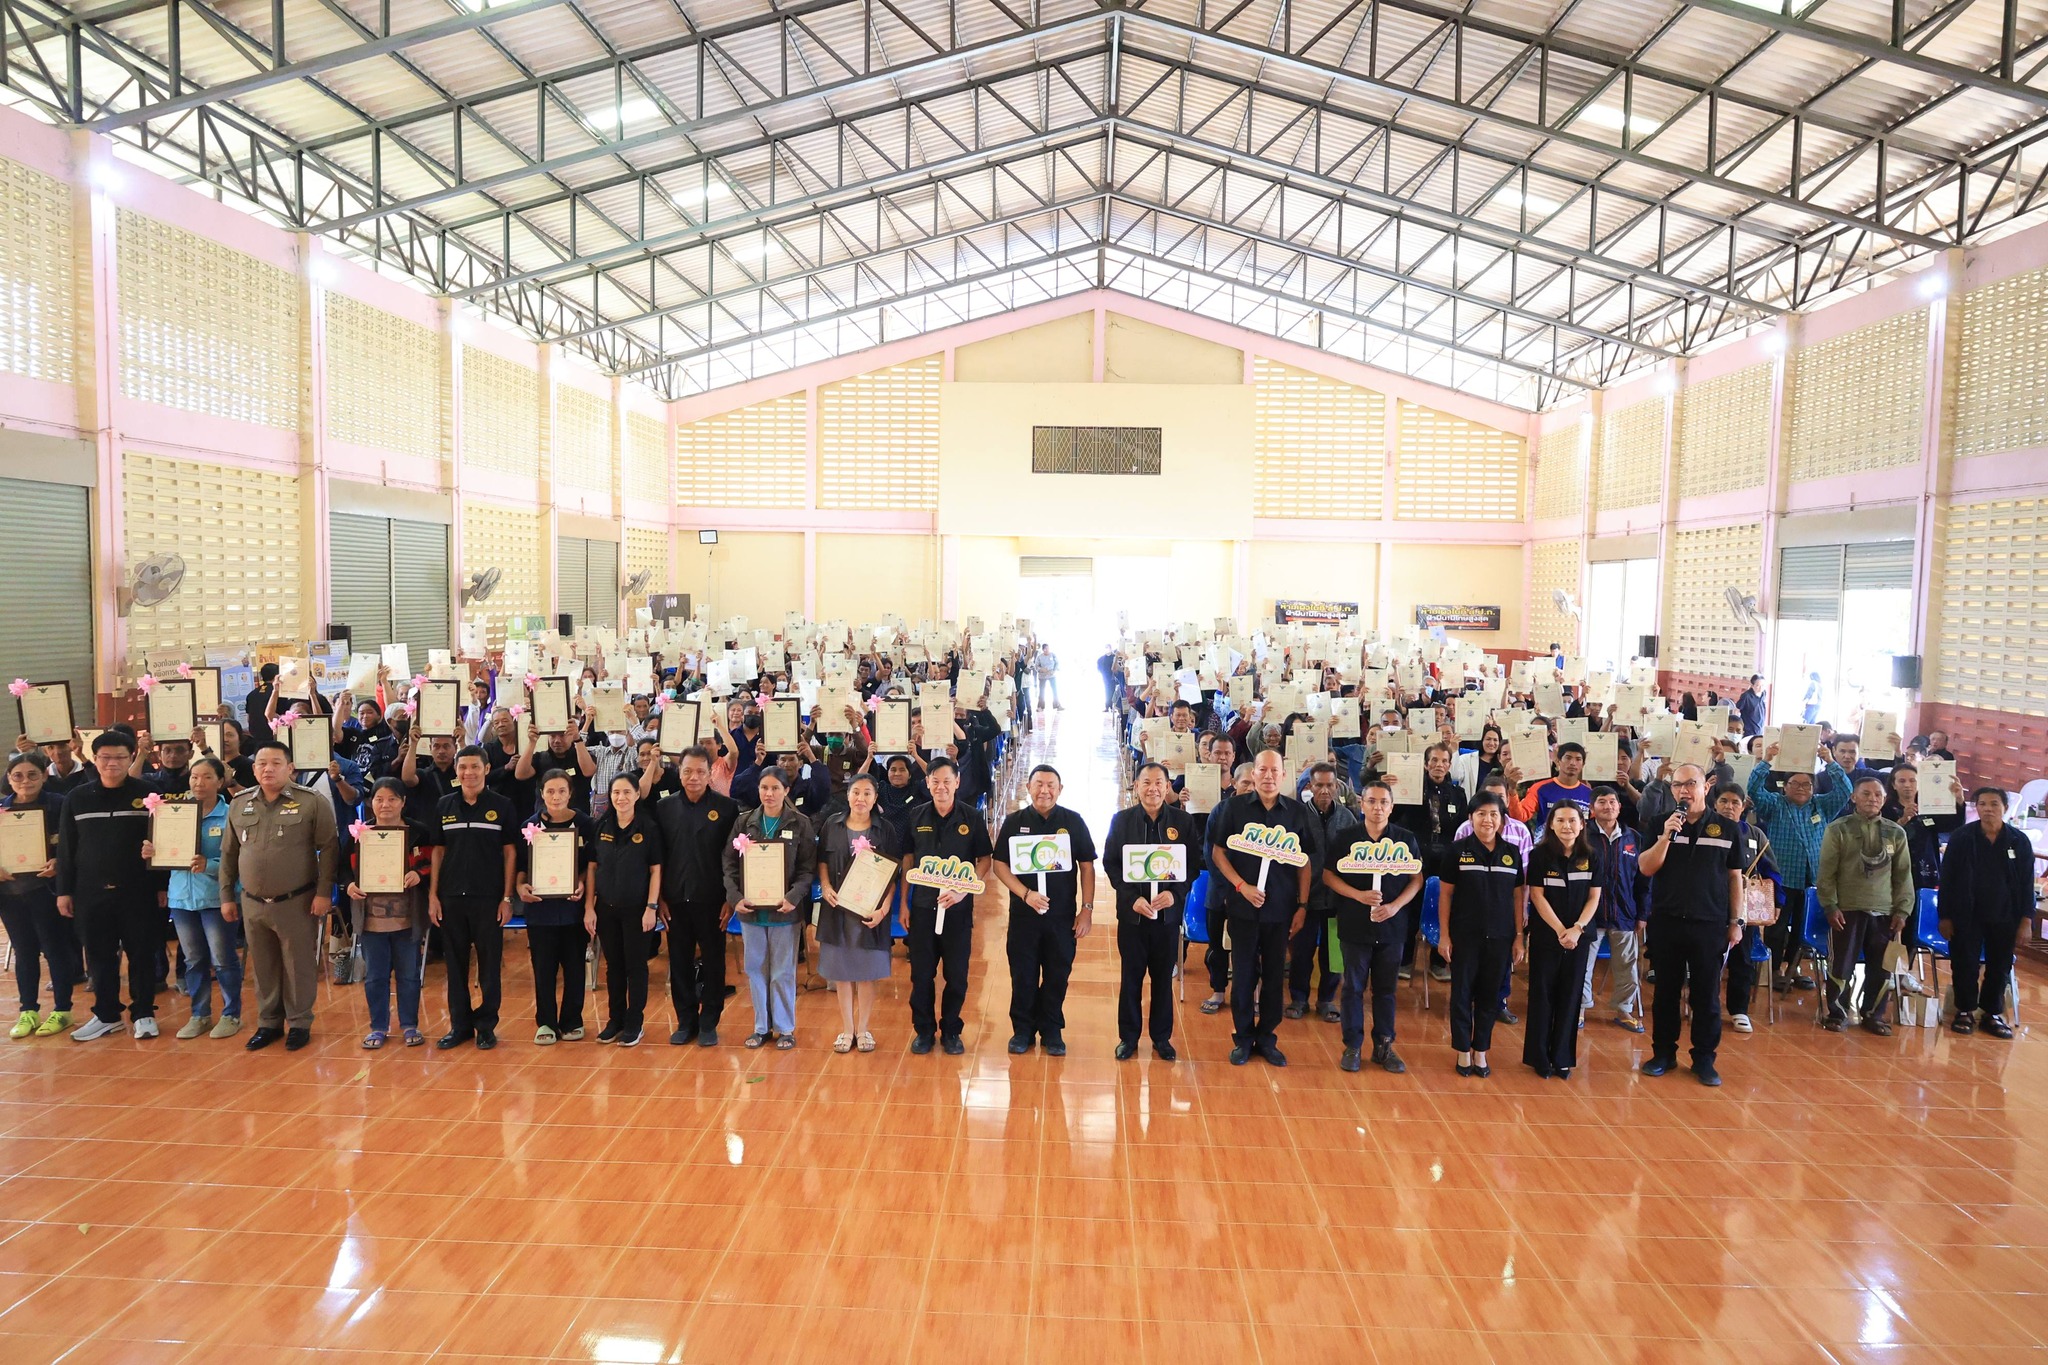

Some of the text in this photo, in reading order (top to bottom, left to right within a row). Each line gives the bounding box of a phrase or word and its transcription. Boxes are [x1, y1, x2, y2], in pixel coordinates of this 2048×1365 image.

[1245, 827, 1297, 853] ส.ป.ก.
[1354, 843, 1408, 862] ส.ป.ก.
[923, 860, 973, 881] ส.ป.ก.
